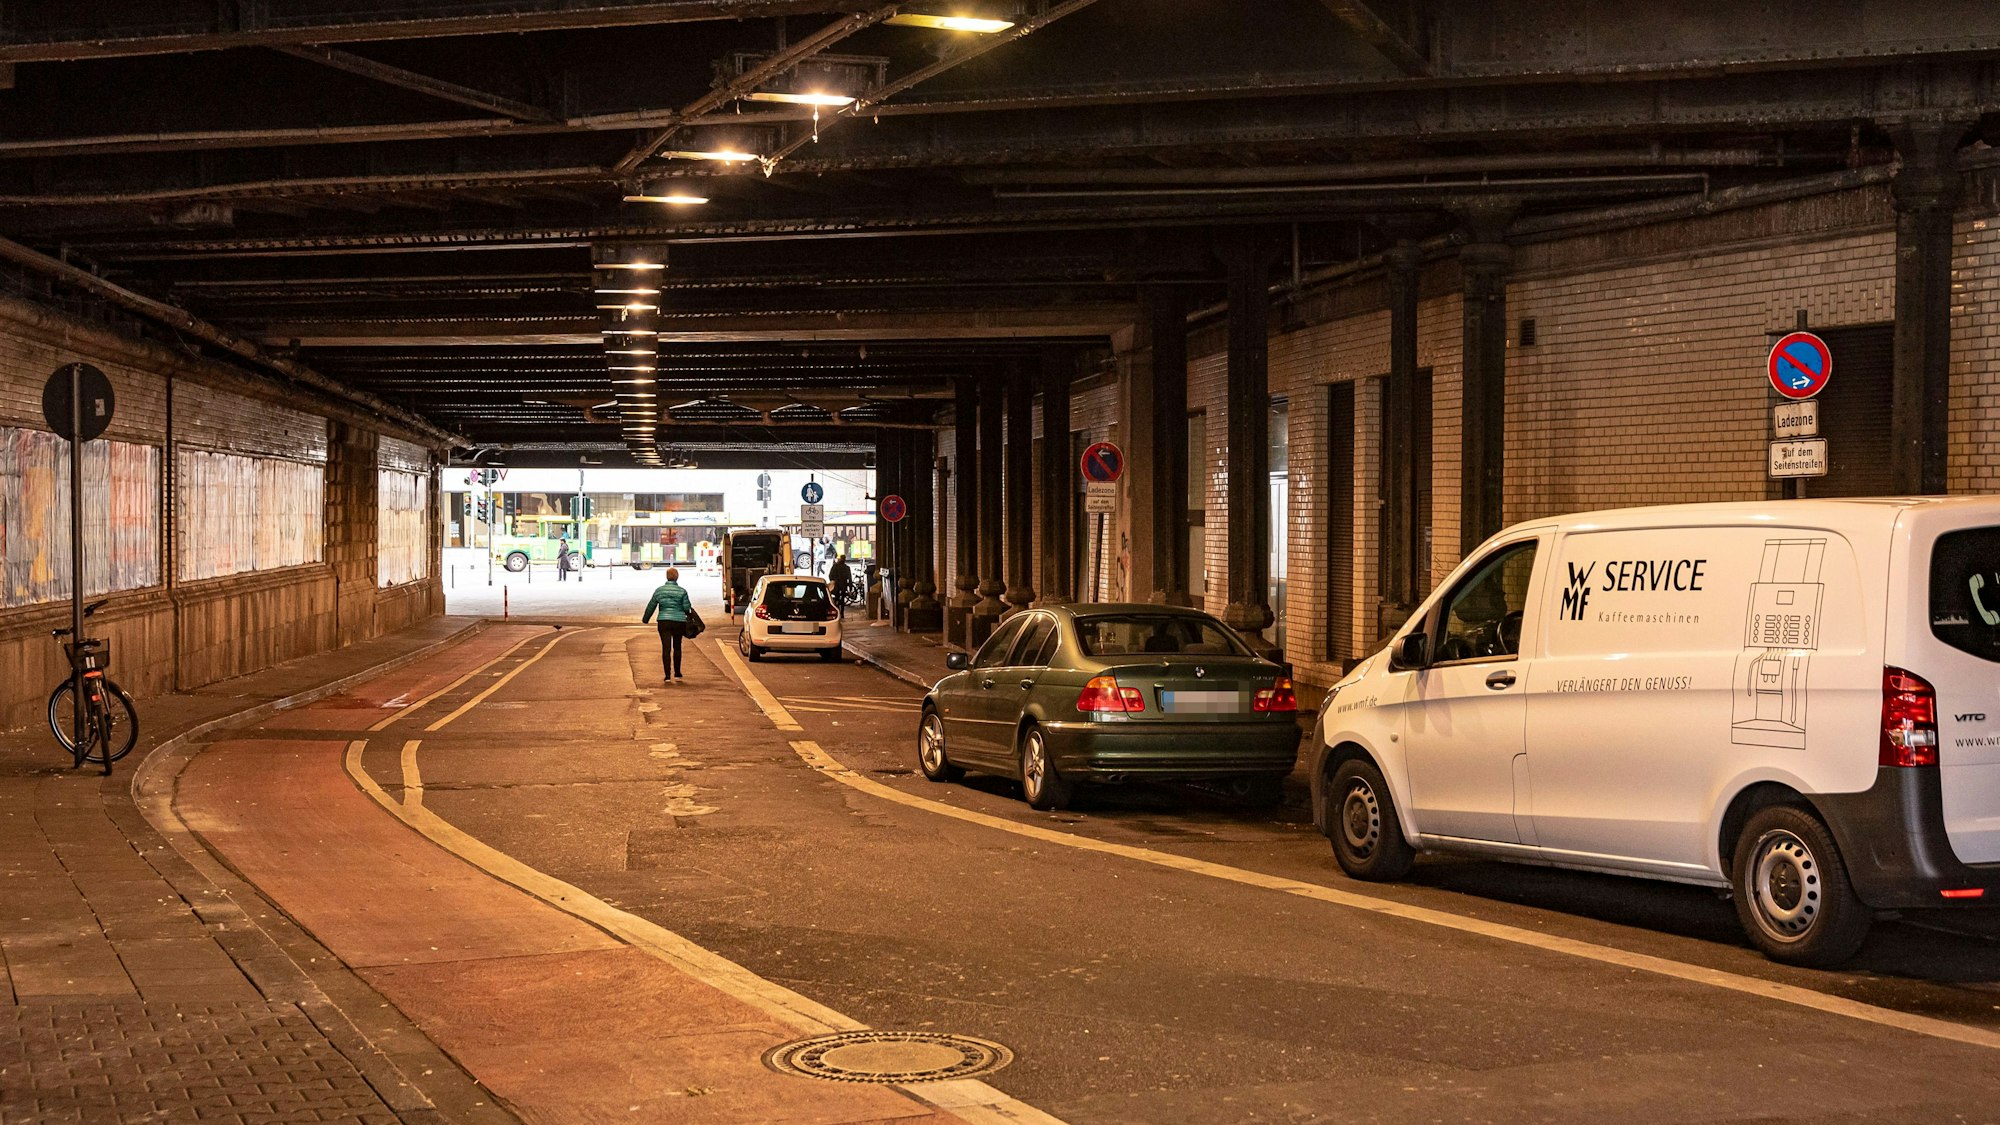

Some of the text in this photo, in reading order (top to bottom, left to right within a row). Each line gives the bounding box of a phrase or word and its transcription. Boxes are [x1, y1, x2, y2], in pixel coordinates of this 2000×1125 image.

[1777, 415, 1813, 428] Ladezone
[1798, 448, 1813, 456] dem
[1774, 459, 1823, 470] Seitenstreifen
[1088, 486, 1115, 494] Ladezone
[1602, 559, 1707, 592] SERVICE
[1598, 611, 1700, 624] Kaffeemaschinen
[1557, 677, 1618, 692] VERLÄNGERT
[1620, 678, 1642, 691] DEN
[1645, 676, 1693, 690] GENUSS!
[1337, 694, 1378, 714] www.wmf.de
[1954, 713, 1986, 722] VITO
